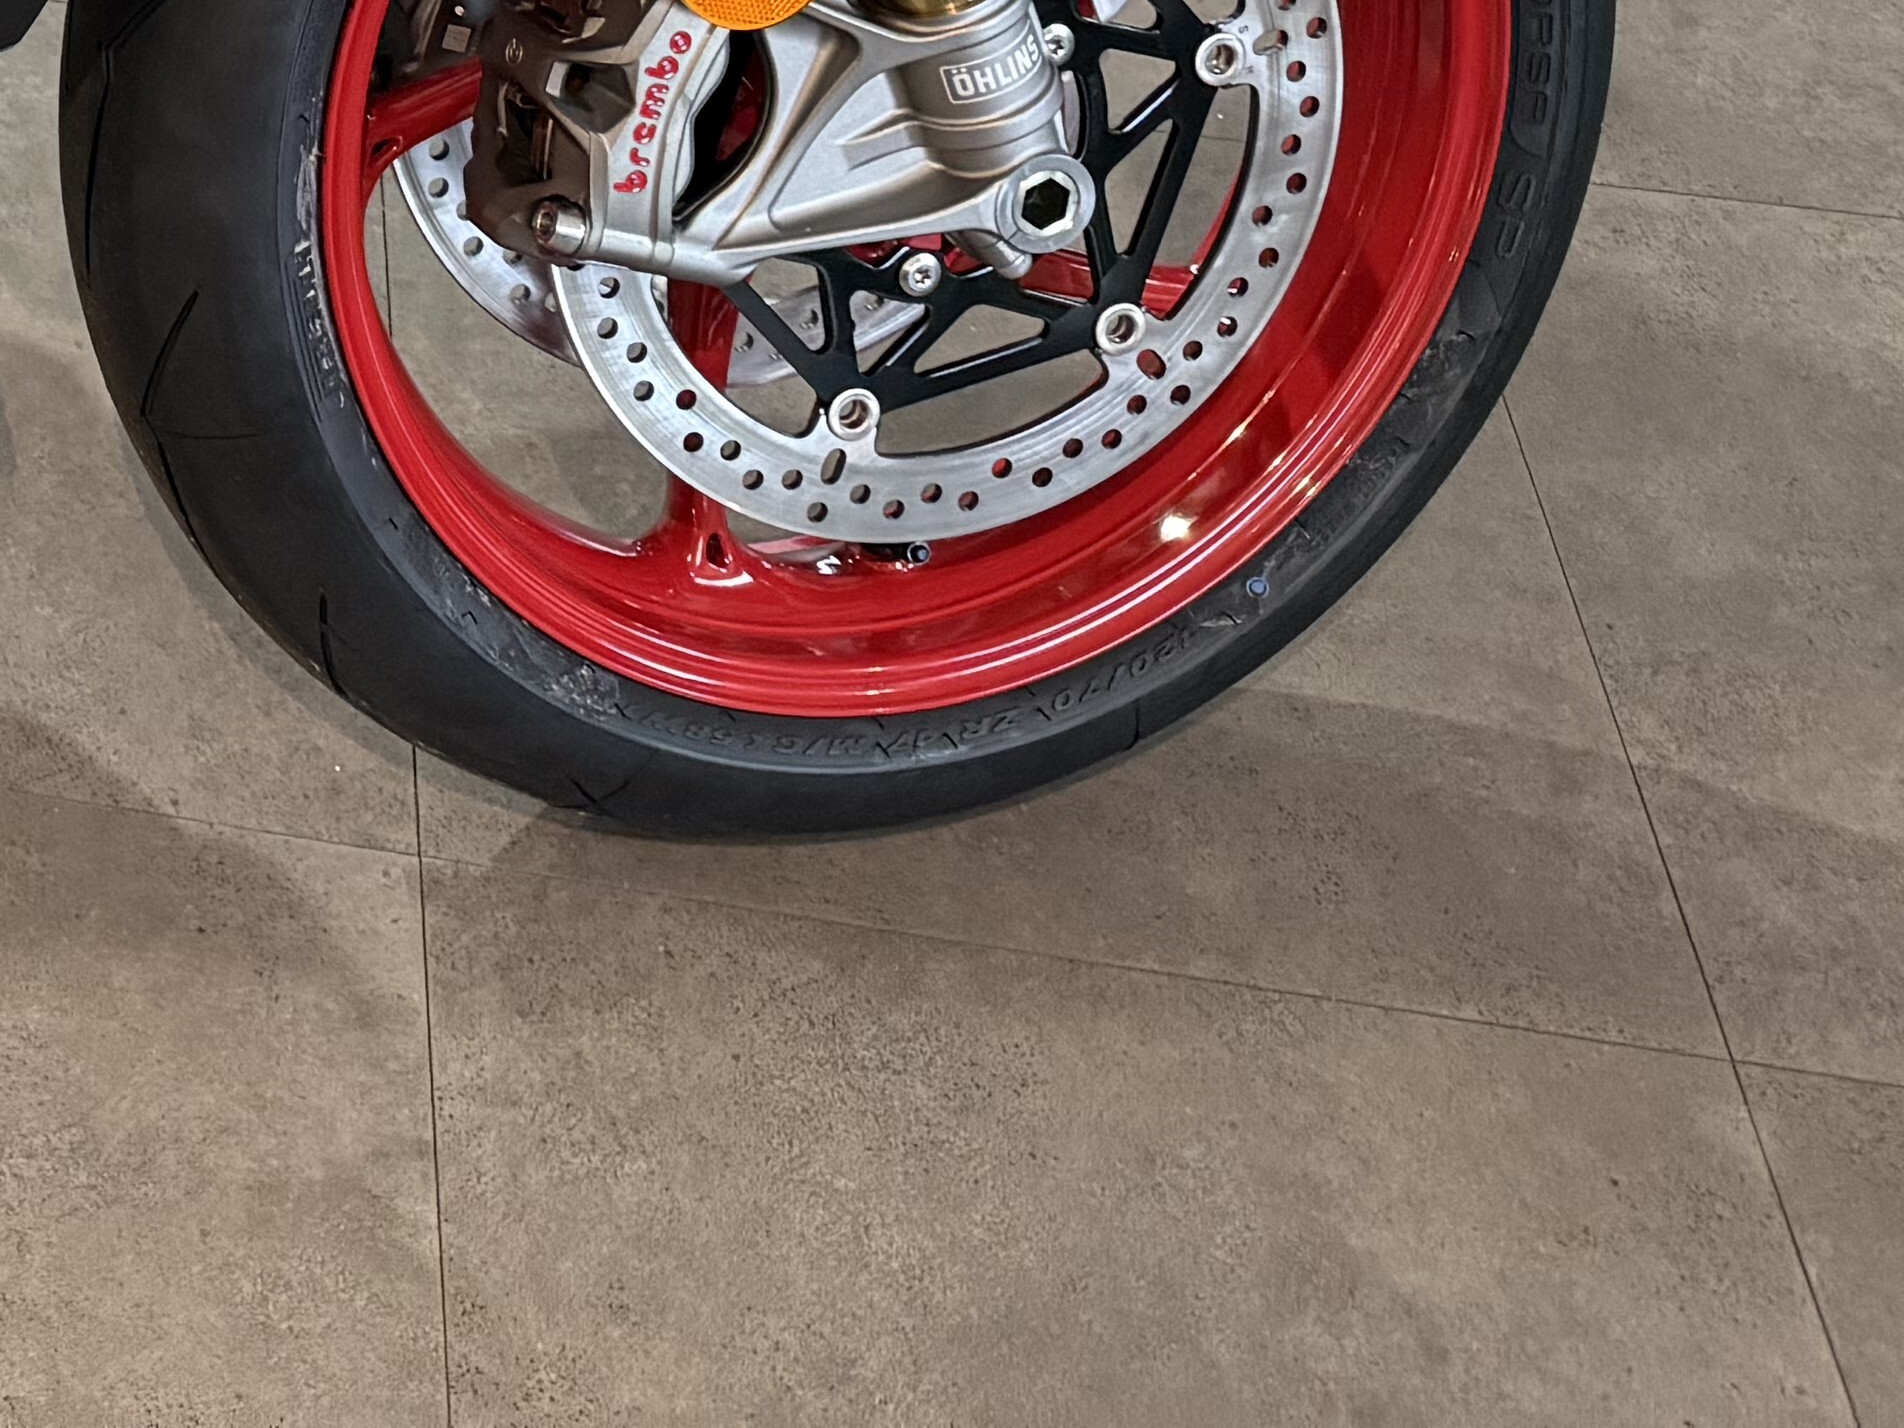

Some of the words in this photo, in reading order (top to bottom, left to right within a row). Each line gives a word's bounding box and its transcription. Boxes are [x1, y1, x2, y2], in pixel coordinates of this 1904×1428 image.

[614, 28, 692, 195] brembo
[954, 37, 1043, 99] ÖHLINS
[1491, 172, 1535, 262] SP
